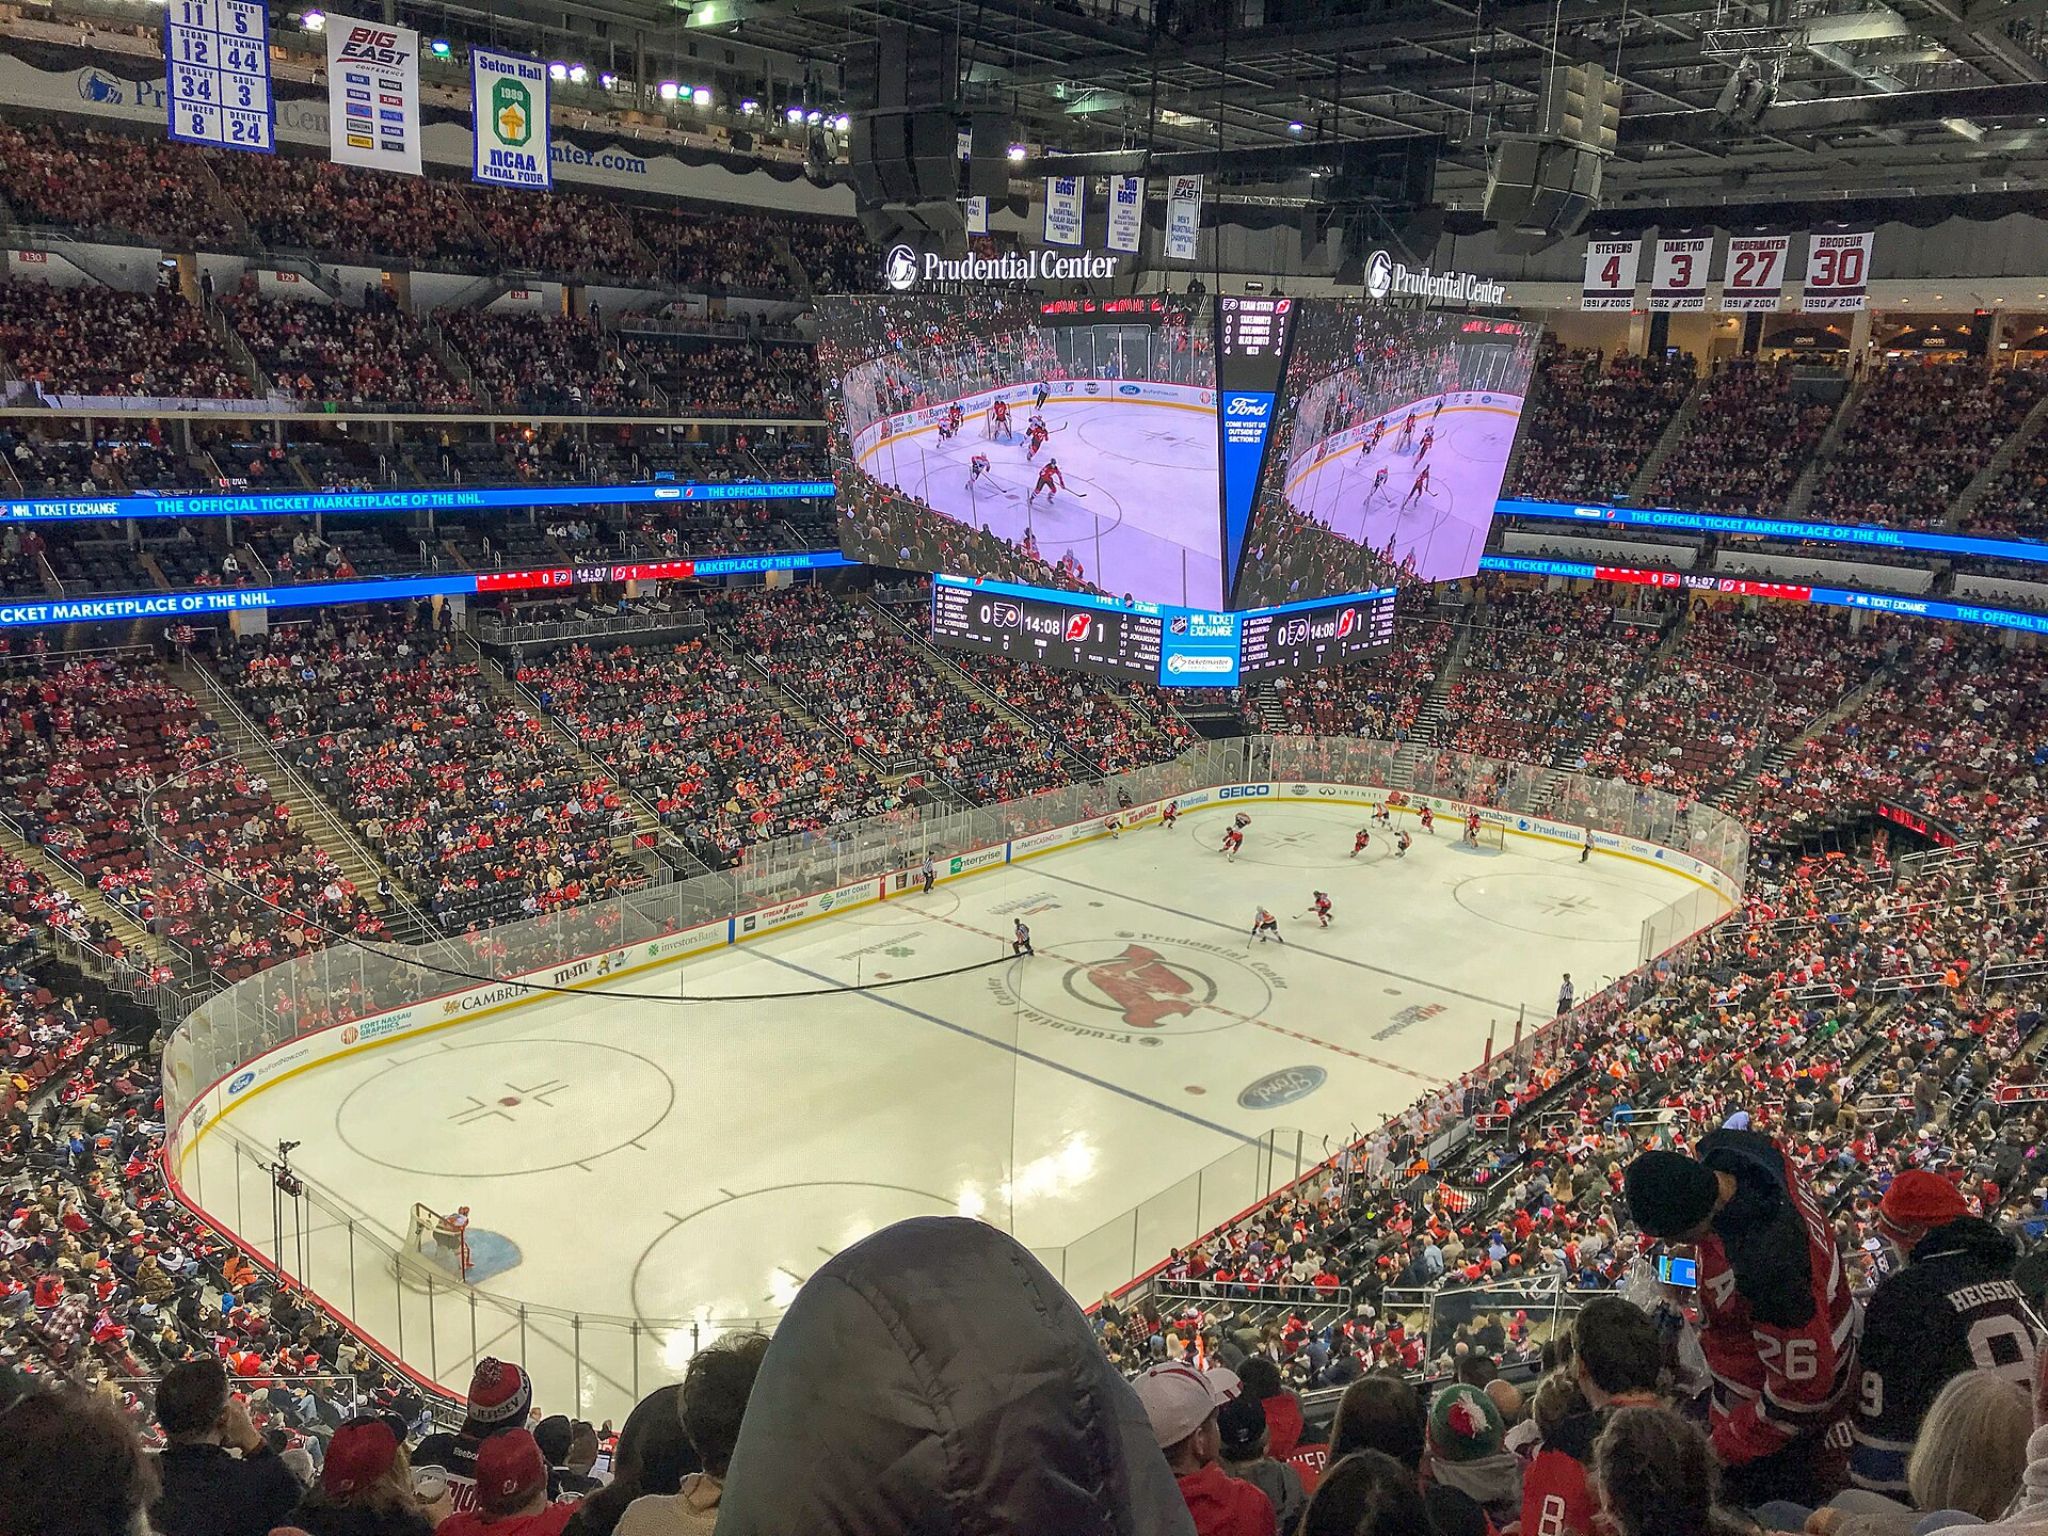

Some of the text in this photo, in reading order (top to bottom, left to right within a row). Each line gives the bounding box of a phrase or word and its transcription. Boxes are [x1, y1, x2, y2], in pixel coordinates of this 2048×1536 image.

[182, 2, 203, 26] 11
[227, 1, 254, 13] DUKES
[235, 12, 248, 34] 5
[222, 37, 262, 51] WERKMAN
[349, 27, 397, 49] BIG
[183, 39, 208, 64] 12
[228, 48, 258, 72] 44
[341, 42, 410, 66] EAST
[179, 65, 213, 79] MOSLEY
[355, 64, 405, 77] CONFERENCE
[479, 55, 542, 81] Seton Hall
[181, 75, 211, 100] 34
[233, 75, 255, 86] SAUL
[238, 85, 251, 107] 3
[501, 87, 524, 101] 1989
[181, 102, 214, 115] WANZER
[230, 111, 262, 123] DEHERE
[192, 113, 205, 135] 8
[232, 120, 261, 143] 24
[490, 149, 536, 172] NCAA
[550, 145, 647, 174] nter.com
[483, 165, 544, 184] FINAL FOUR
[1173, 187, 1200, 199] EAST
[1177, 178, 1195, 190] BIG
[1595, 242, 1633, 255] STEVENS
[1663, 240, 1704, 252] DANEYKO
[1732, 238, 1786, 252] NIEDERMAYER
[1819, 236, 1862, 248] BRODEUR
[923, 249, 1117, 281] Prudential Center
[1601, 255, 1621, 289] 4
[1669, 254, 1693, 288] 3
[1733, 251, 1778, 287] 27
[1811, 248, 1865, 287] 30
[1393, 262, 1506, 305] Prudential Center
[1583, 299, 1631, 308] 1991 2005
[1651, 299, 1703, 308] 1982 2003
[1724, 299, 1776, 308] 1991 2004
[1804, 297, 1861, 308] 1990 2014
[1226, 314, 1233, 324] 0
[1225, 325, 1232, 335] 0
[1224, 335, 1231, 344] 0
[1224, 346, 1282, 357] 4 4
[1227, 397, 1268, 416] Ford
[708, 484, 835, 498] THE OFFICIAL TICKET MARKET
[12, 502, 119, 517] NHL TICKET EXCHANGE
[156, 492, 485, 514] THE OFFICIAL TICKET MARKETPLACE OF THE NHL.
[1631, 512, 1904, 544] THE OFFICIAL TICKET MARKETPLACE OF THE NHL.
[576, 567, 607, 578] 14:07
[761, 559, 774, 570] OF
[775, 558, 792, 568] THE
[793, 557, 814, 568] NHL.
[1479, 557, 1594, 576] FICIAL TICKET MARKET
[542, 574, 549, 584] 0
[631, 569, 637, 578] 1
[1651, 573, 1659, 584] 0
[1683, 575, 1716, 587] 14:07
[1739, 582, 1746, 593] 1
[0, 592, 276, 623] CKET MARKETPLACE OF THE NHL.
[1857, 596, 1928, 613] NHL TICKET EXCHANGE
[980, 605, 991, 624] 0
[1139, 617, 1161, 627] MOORE
[1190, 614, 1235, 625] NHL TICKET
[1357, 613, 1362, 632] 1
[1956, 607, 1980, 619] THE
[1982, 611, 2034, 628] OFFICIAL
[1024, 615, 1060, 636] 14:08
[1096, 623, 1104, 643] 1
[1134, 624, 1161, 636] VATANEN
[1190, 625, 1233, 637] EXCHANGE
[1311, 622, 1335, 640] 14:08
[1129, 633, 1161, 644] JOHANSSON
[1278, 626, 1287, 646] 0
[1140, 643, 1160, 653] ZAJAC
[1180, 793, 1209, 808] Prudential
[1219, 784, 1270, 799] GEICO
[1339, 789, 1382, 799] INFINITI
[1533, 823, 1580, 841] Prudential
[955, 850, 1001, 870] enterprise
[835, 883, 871, 899] EAST COAST
[762, 901, 808, 919] STREAM GAMES
[1140, 932, 1288, 990] Prudential Center
[461, 983, 530, 1011] CAMBRIA
[987, 977, 1132, 1045] Center Prudential
[360, 1011, 412, 1030] FORT NASSAU
[360, 1022, 400, 1037] GRAPHICS
[1252, 1071, 1313, 1101] Ford
[1704, 1268, 1736, 1309] A
[1947, 1279, 2029, 1313] HEISEN
[1753, 1329, 1818, 1381] 26
[1861, 1370, 1884, 1418] 9
[473, 1398, 520, 1419] JERSEY
